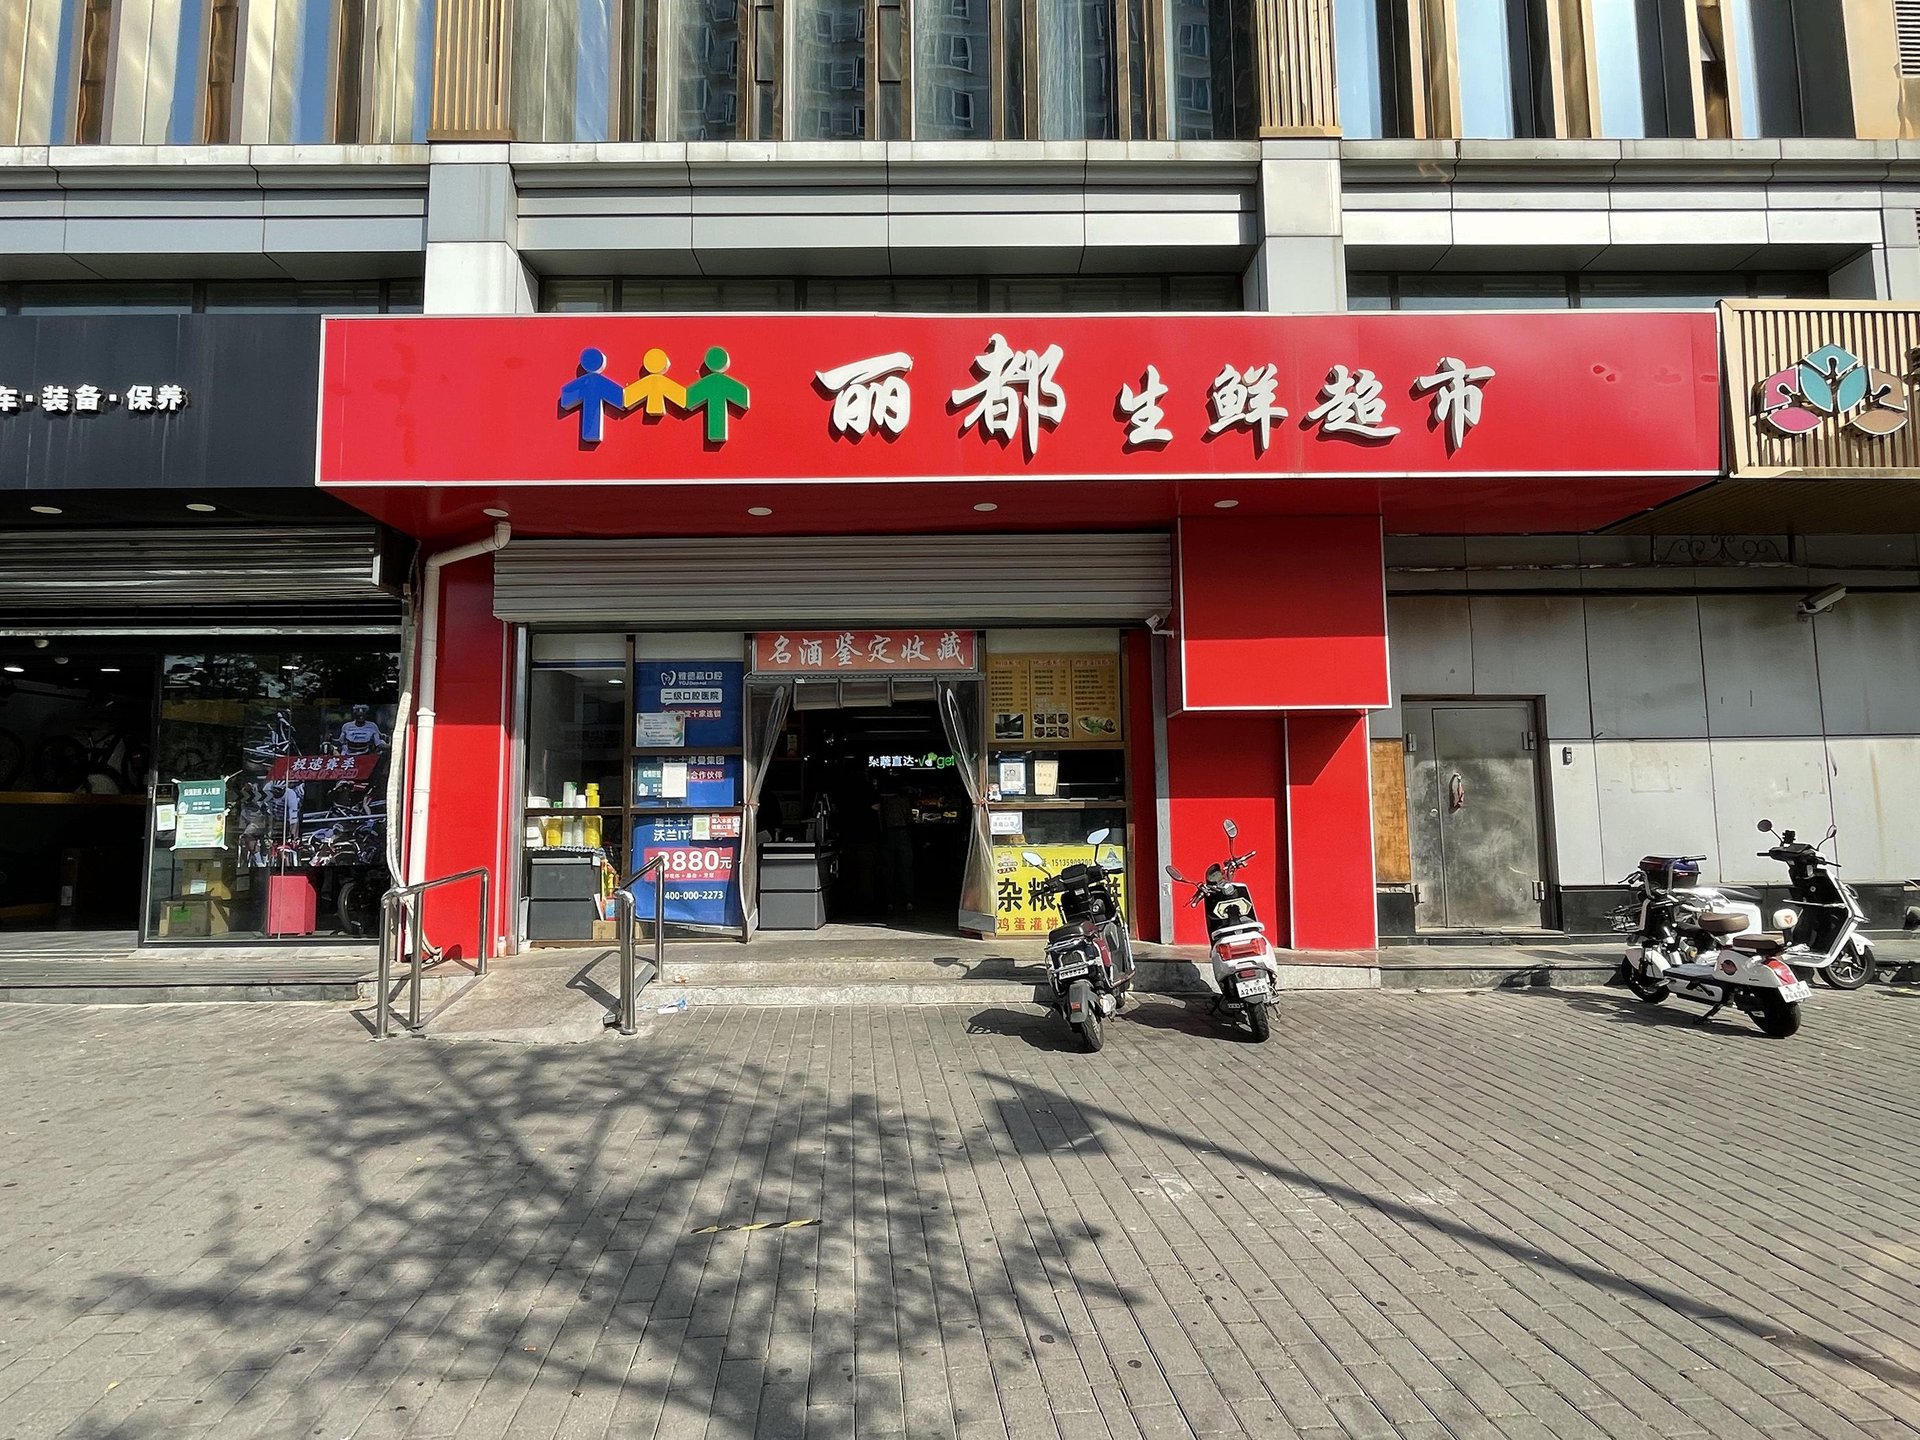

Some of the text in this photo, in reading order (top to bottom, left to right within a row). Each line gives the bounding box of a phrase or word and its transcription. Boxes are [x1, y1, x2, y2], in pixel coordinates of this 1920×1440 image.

[815, 333, 1495, 455] 丽都生鲜超市
[768, 632, 965, 666] 名酒鉴定收藏
[664, 691, 719, 701] 二级口腔医院
[687, 770, 723, 779] 合作伙伴
[664, 891, 724, 900] 400-000-2273
[997, 917, 1059, 931] 鸡蛋灌饼
